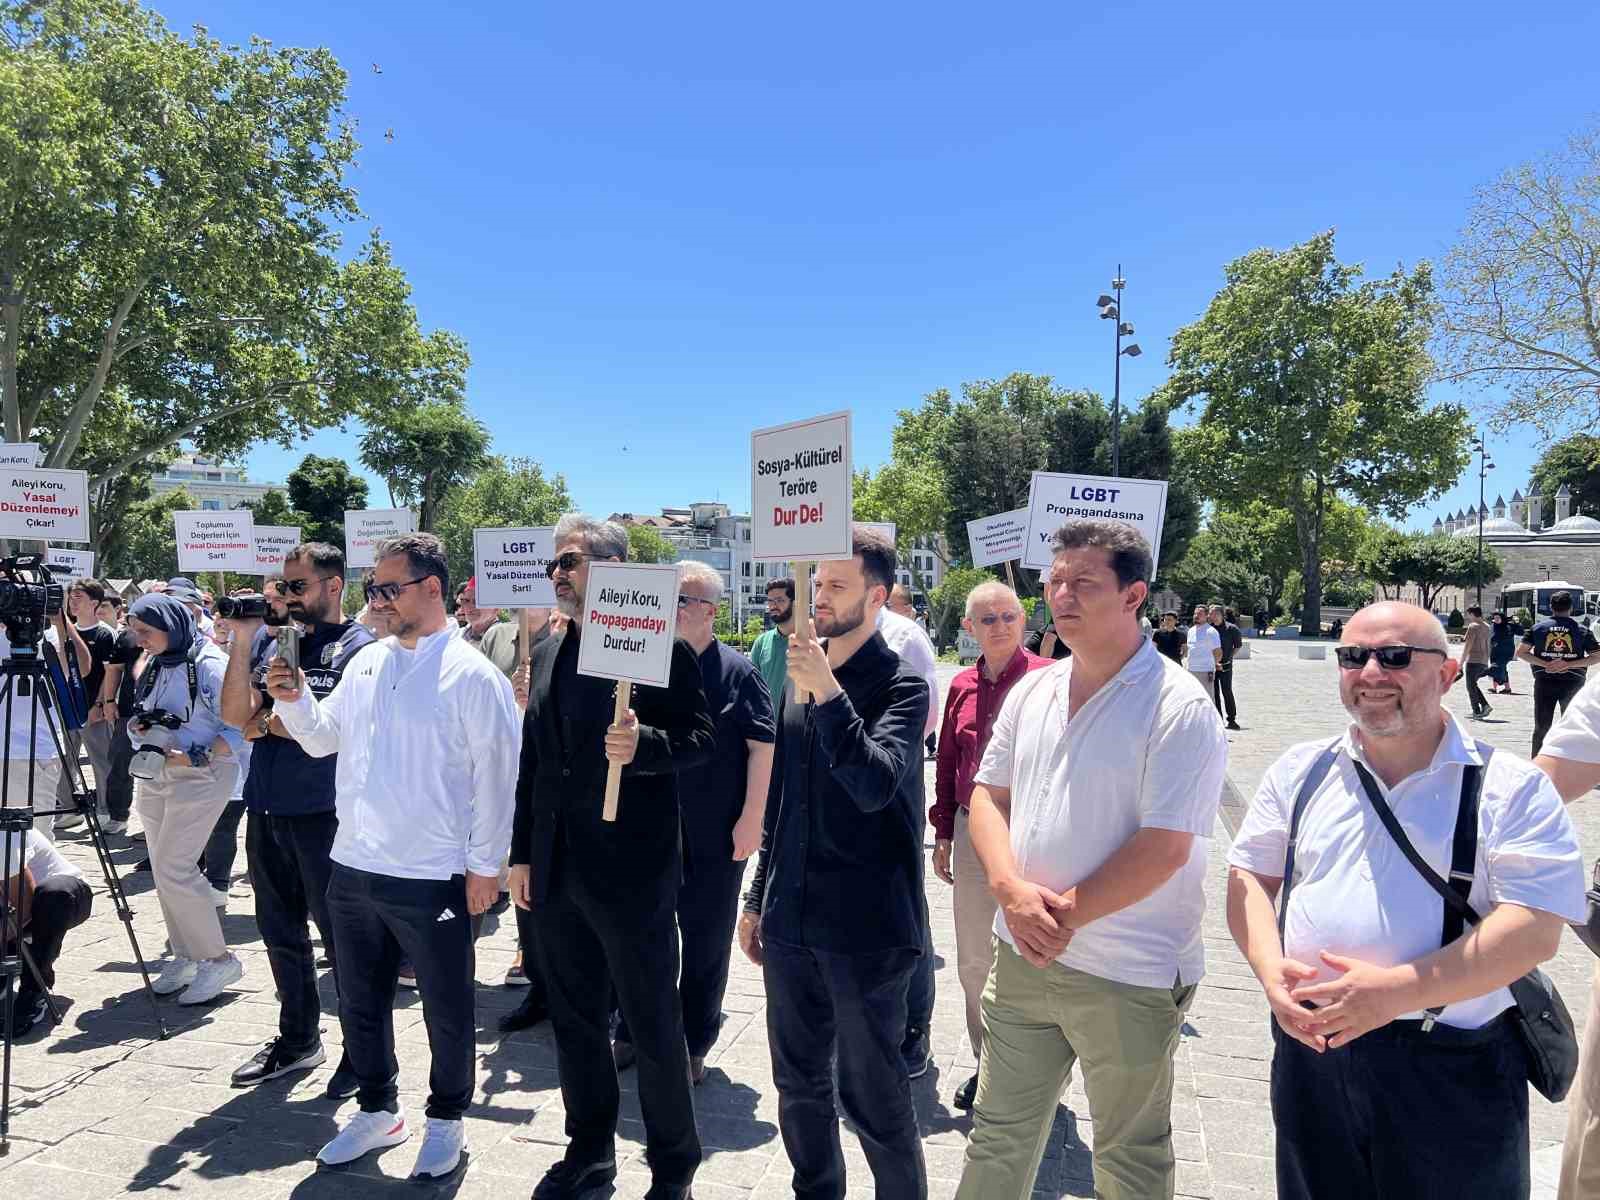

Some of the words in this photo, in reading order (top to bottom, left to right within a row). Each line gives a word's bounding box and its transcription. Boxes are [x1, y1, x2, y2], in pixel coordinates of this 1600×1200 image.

[757, 444, 842, 477] Sosya-Kültürel
[12, 479, 39, 490] Aileyi
[40, 481, 66, 491] Koru,
[779, 478, 817, 497] Teröre
[24, 492, 56, 503] Yasal
[1070, 486, 1120, 503] LGBT
[1, 502, 79, 517] Düzenlemeyi
[774, 507, 798, 527] Dur
[799, 502, 823, 524] De!
[1046, 503, 1144, 521] Propagandasına
[26, 518, 55, 528] Çıkar!
[196, 521, 233, 529] Toplumun
[503, 542, 535, 553] LGBT
[484, 559, 536, 568] Dayatmasına
[487, 572, 509, 580] Yasal
[599, 588, 630, 607] Aileyi
[631, 590, 661, 610] Koru,
[590, 610, 666, 634] Propagandayı
[603, 633, 646, 653] Durdur!
